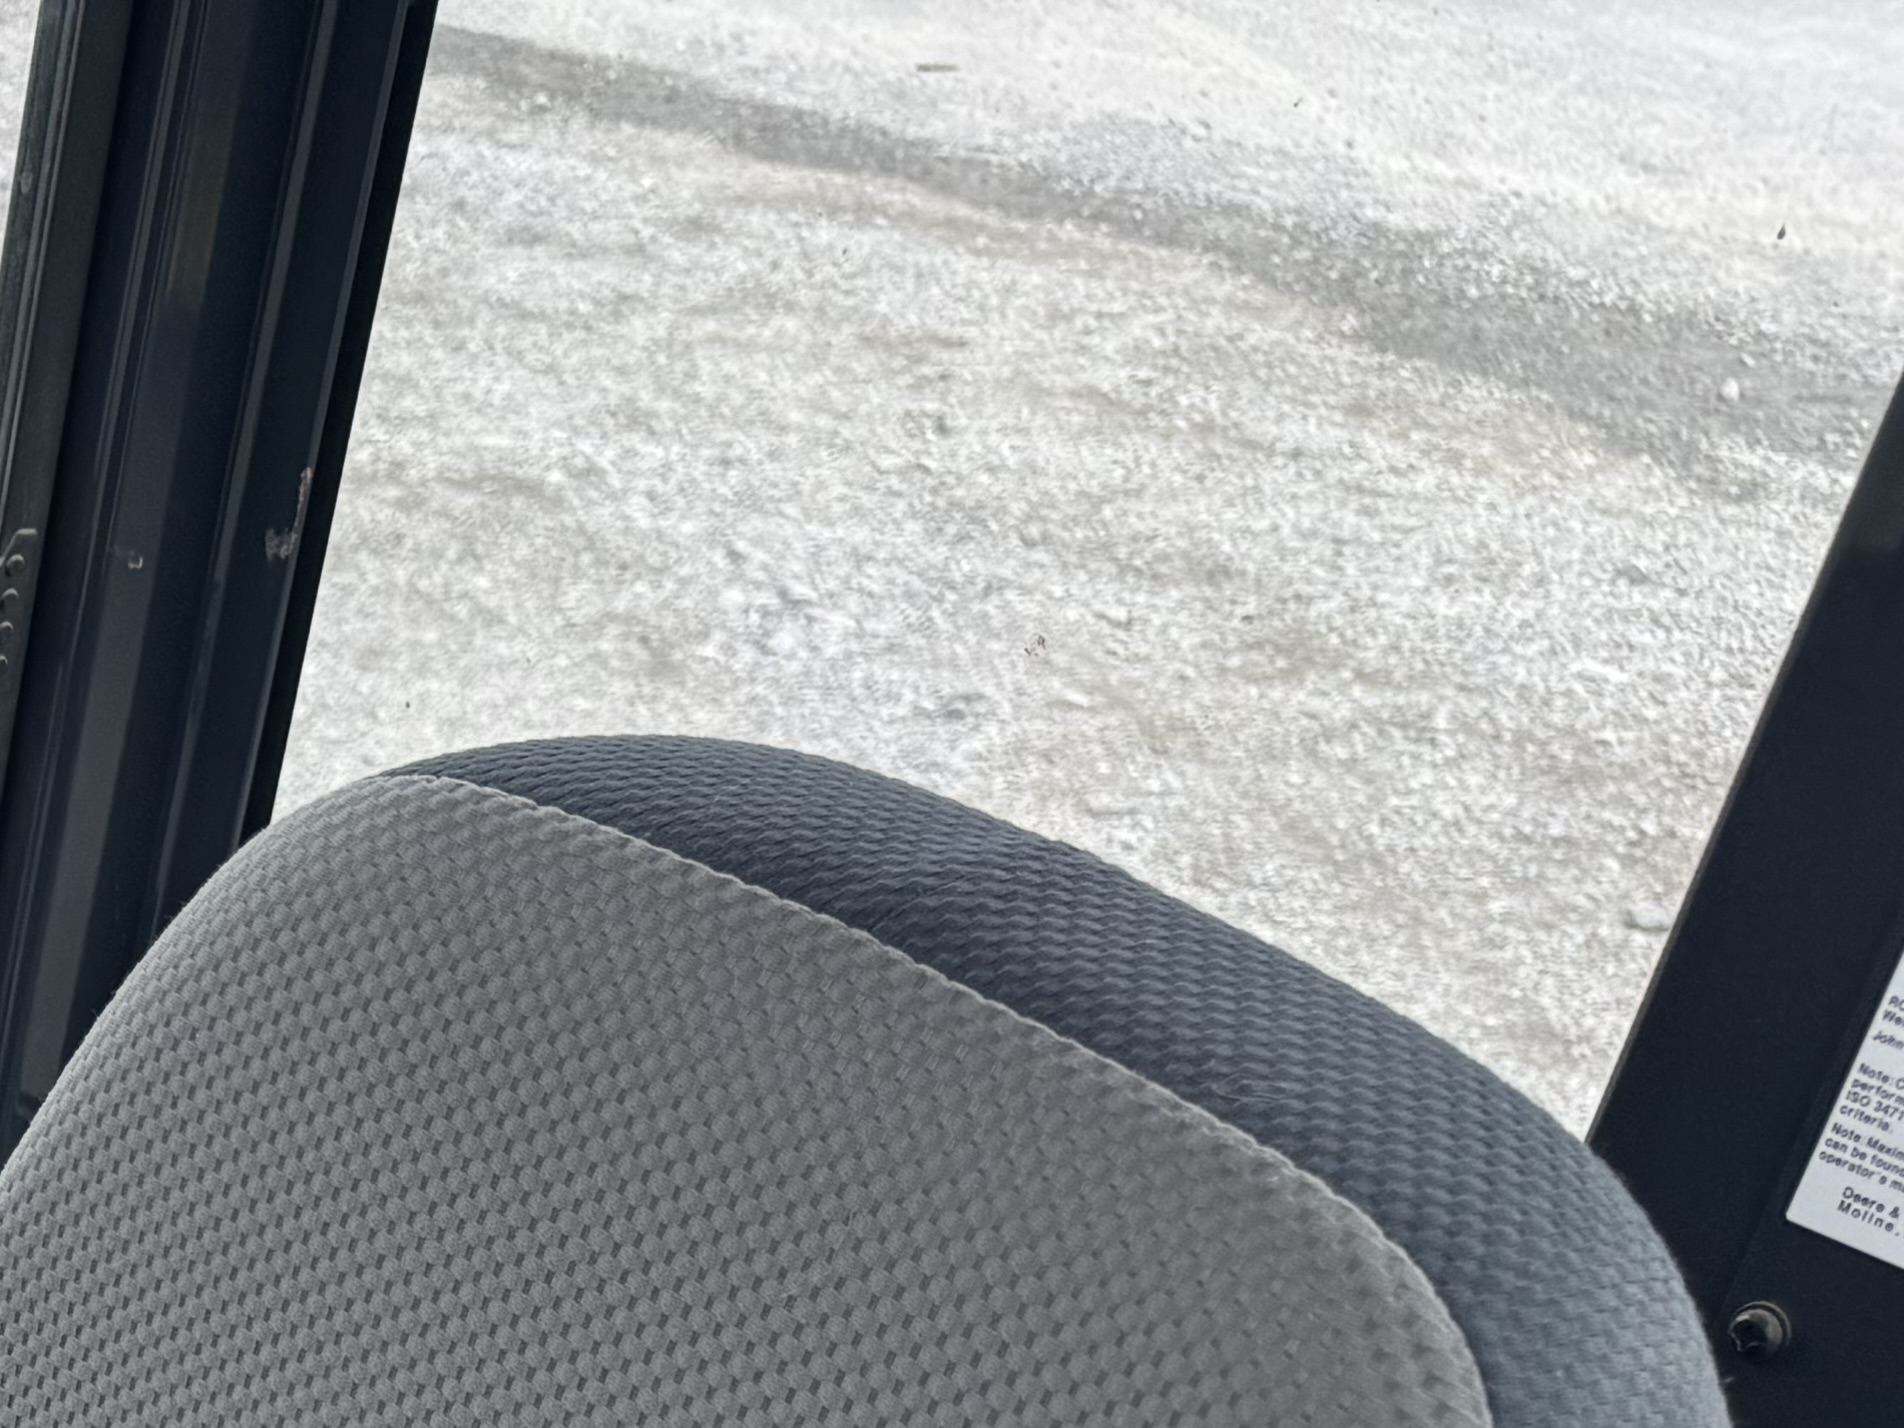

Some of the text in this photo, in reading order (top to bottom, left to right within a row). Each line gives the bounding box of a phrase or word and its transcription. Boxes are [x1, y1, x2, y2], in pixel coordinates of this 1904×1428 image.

[1845, 1091, 1871, 1108] ISO
[1825, 1137, 1847, 1154] can
[1850, 1146, 1867, 1161] be
[1842, 1186, 1900, 1220] Deere &
